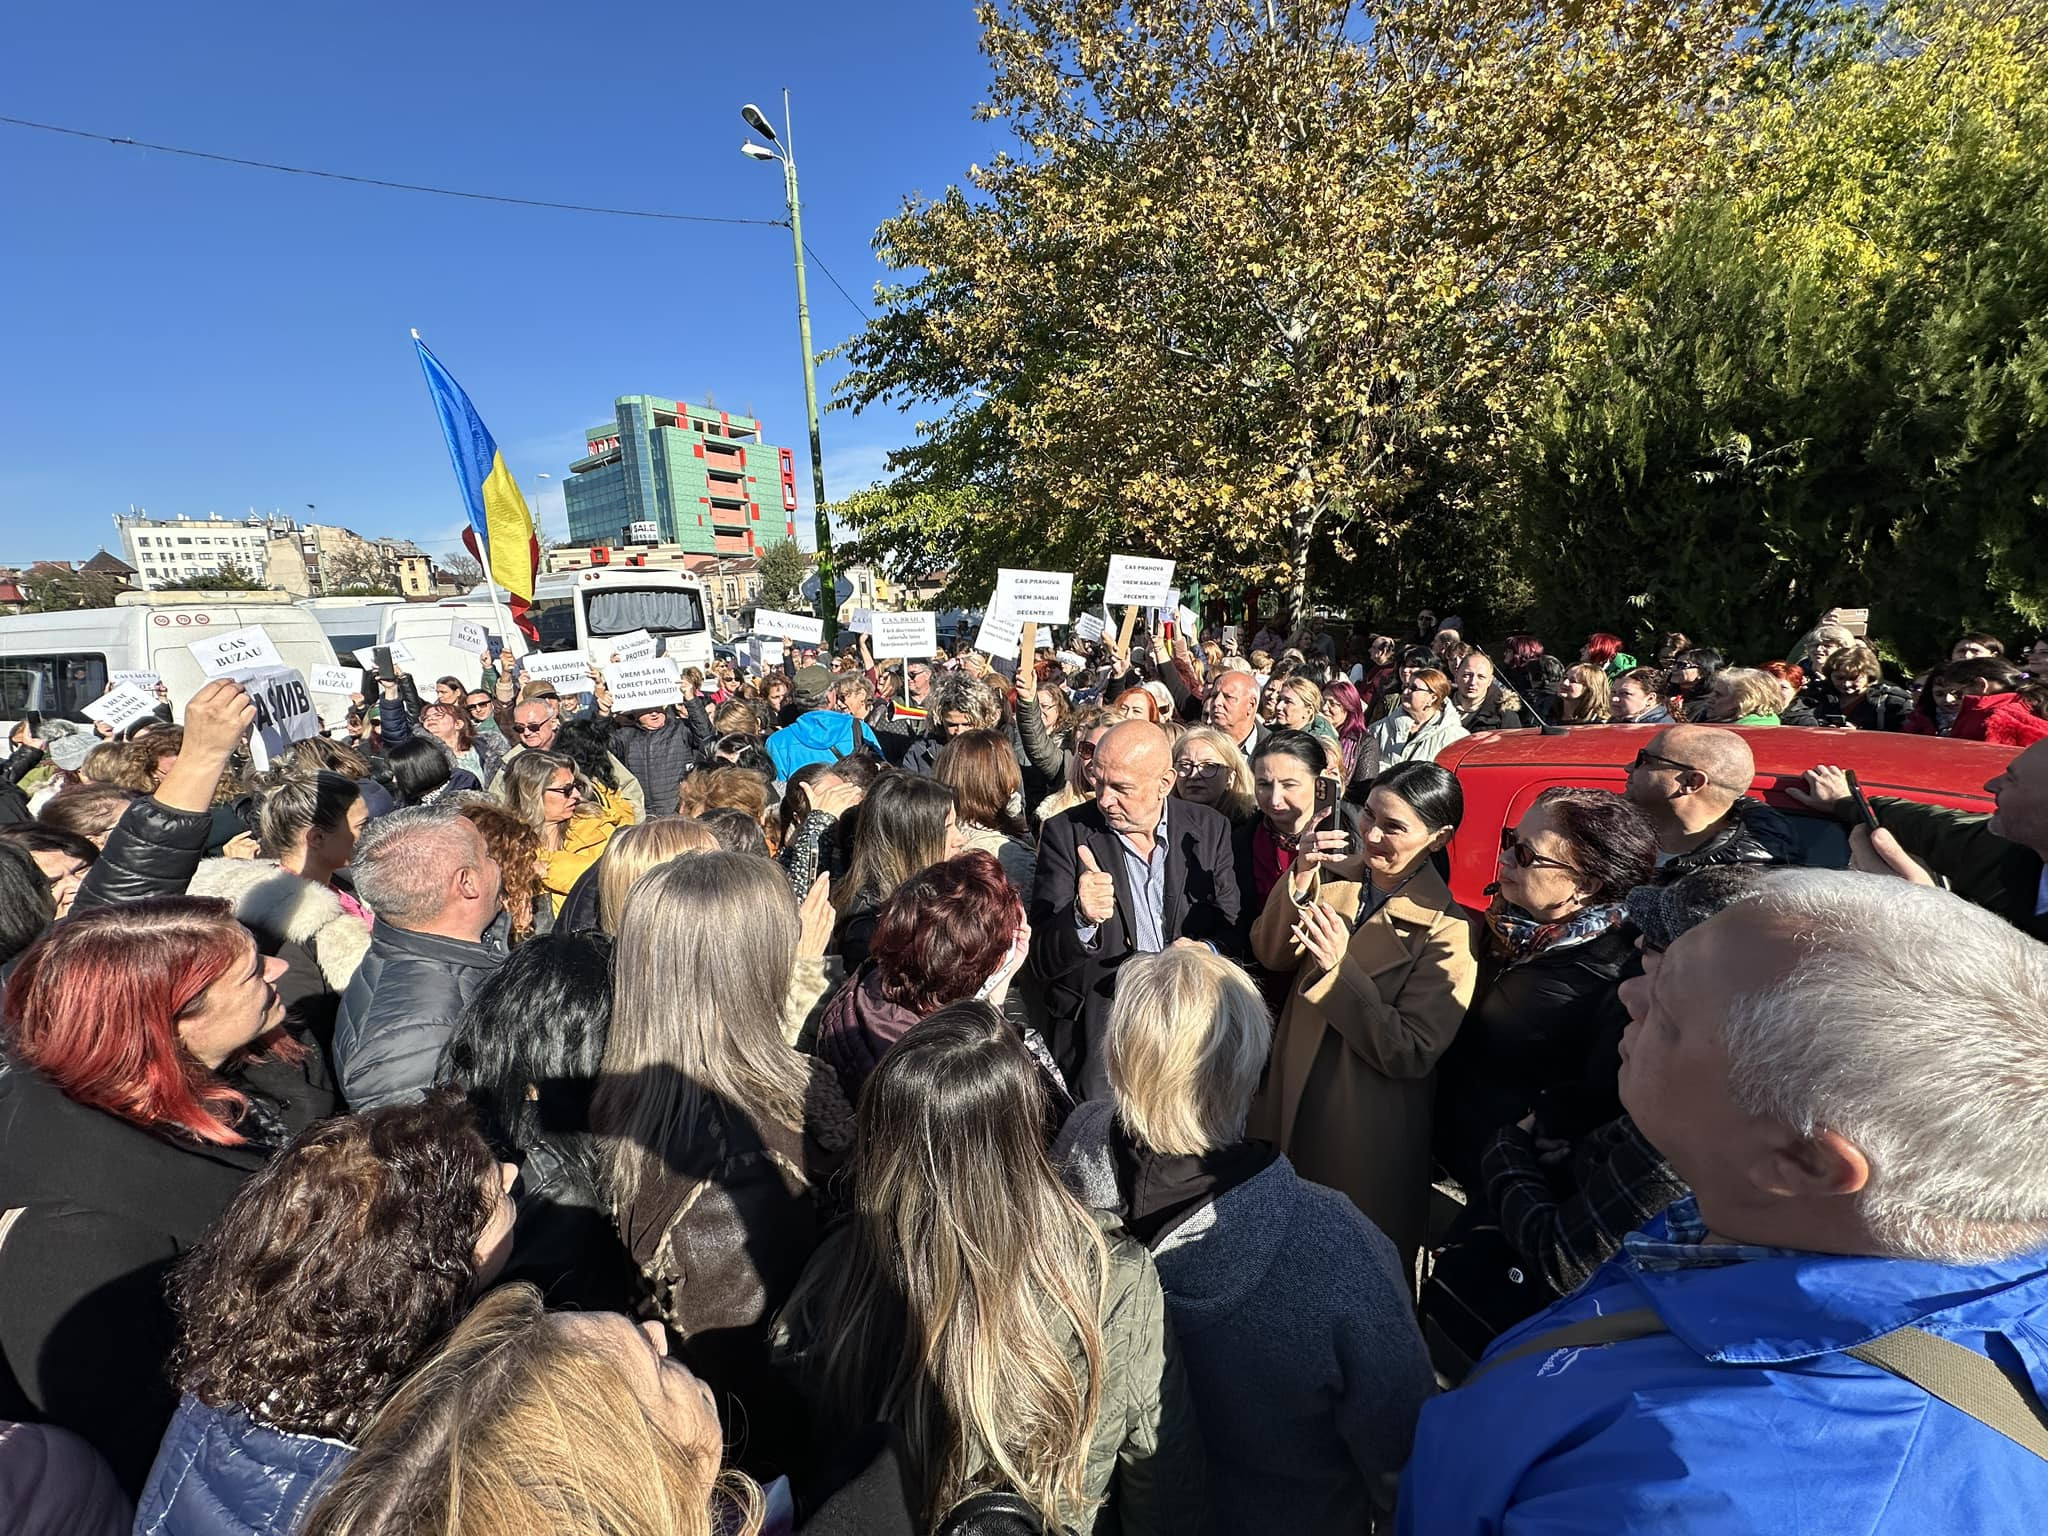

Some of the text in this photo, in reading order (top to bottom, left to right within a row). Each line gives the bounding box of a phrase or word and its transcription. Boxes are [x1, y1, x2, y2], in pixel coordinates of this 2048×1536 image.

[463, 625, 478, 636] CAS
[218, 638, 246, 653] CAS
[625, 648, 650, 661] PROTEST
[530, 665, 551, 673] C.A.S.
[619, 669, 640, 679] VREM
[641, 668, 652, 676] SĂ
[326, 670, 347, 680] CAS
[616, 681, 643, 690] CORECT
[627, 690, 637, 698] SĂ
[638, 689, 648, 697] NE
[102, 693, 127, 709] VREM
[112, 701, 149, 724] DECENTE
